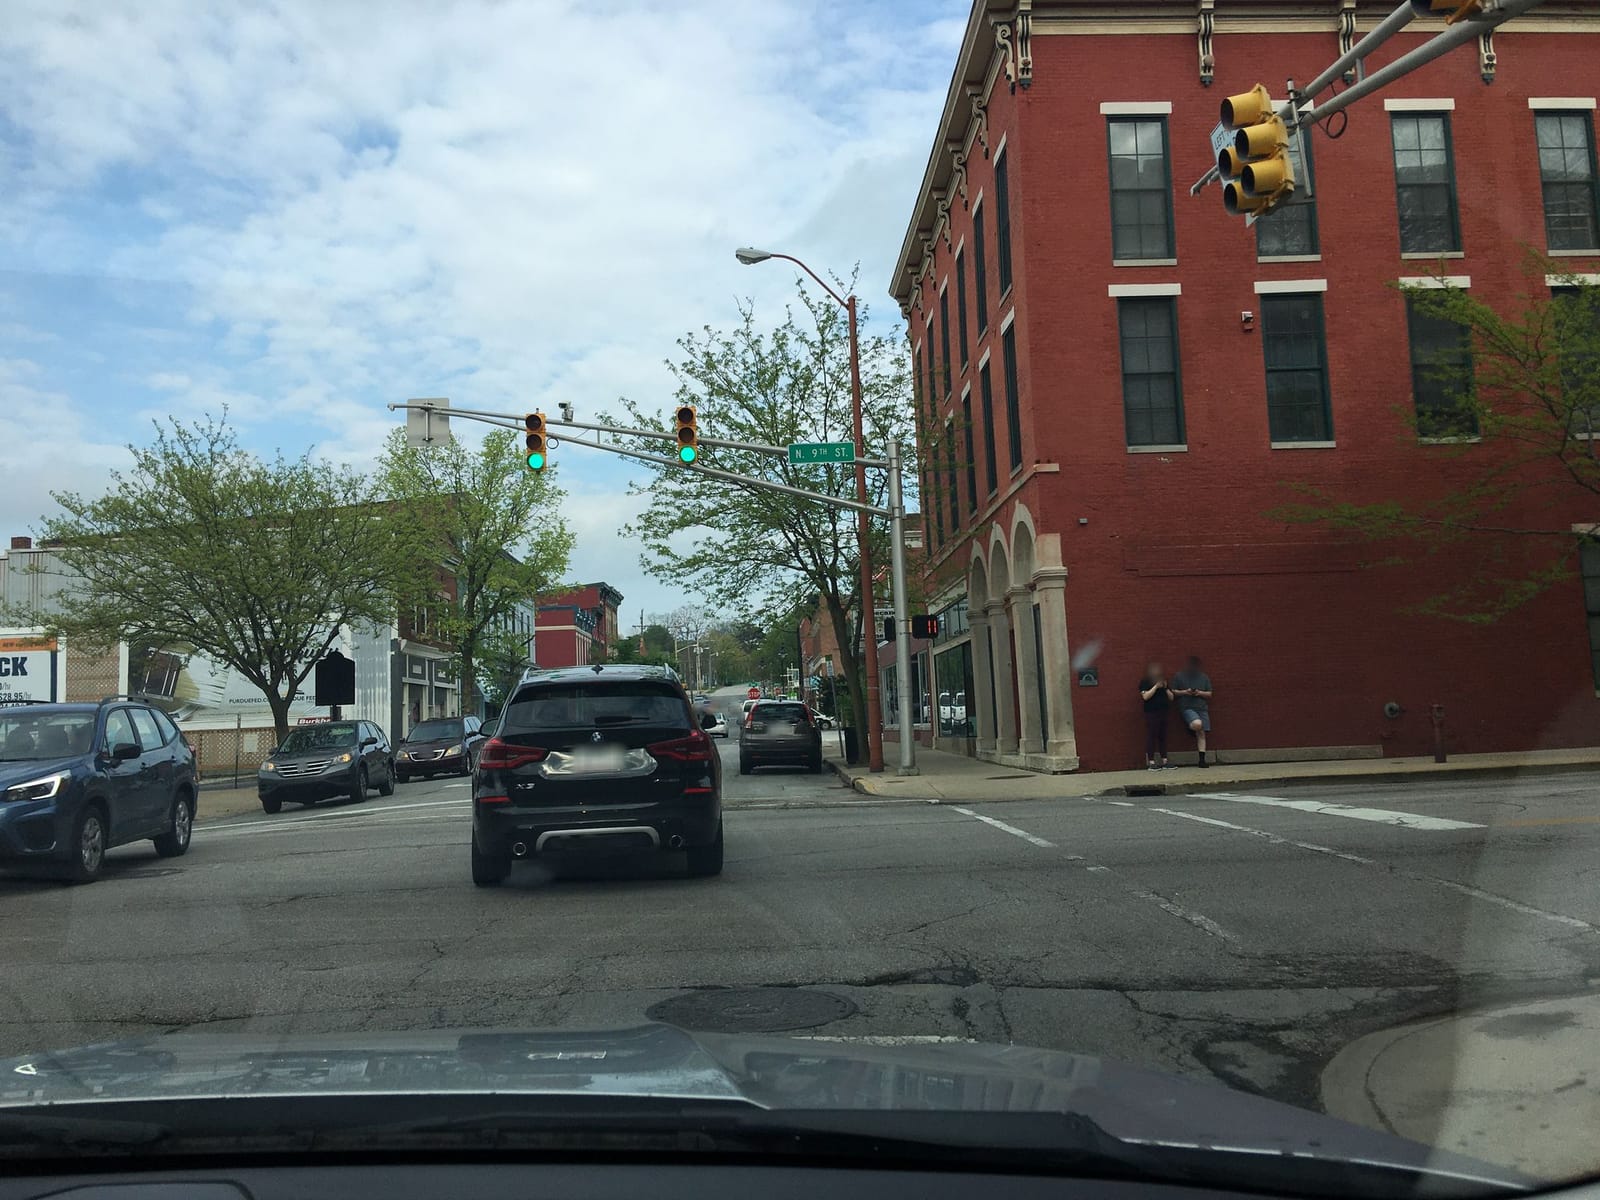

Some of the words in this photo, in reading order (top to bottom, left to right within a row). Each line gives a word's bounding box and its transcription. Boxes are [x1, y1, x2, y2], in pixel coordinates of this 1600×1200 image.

[795, 449, 805, 459] N.
[812, 448, 828, 458] 9TH
[835, 447, 849, 458] ST.
[0, 656, 28, 676] CK
